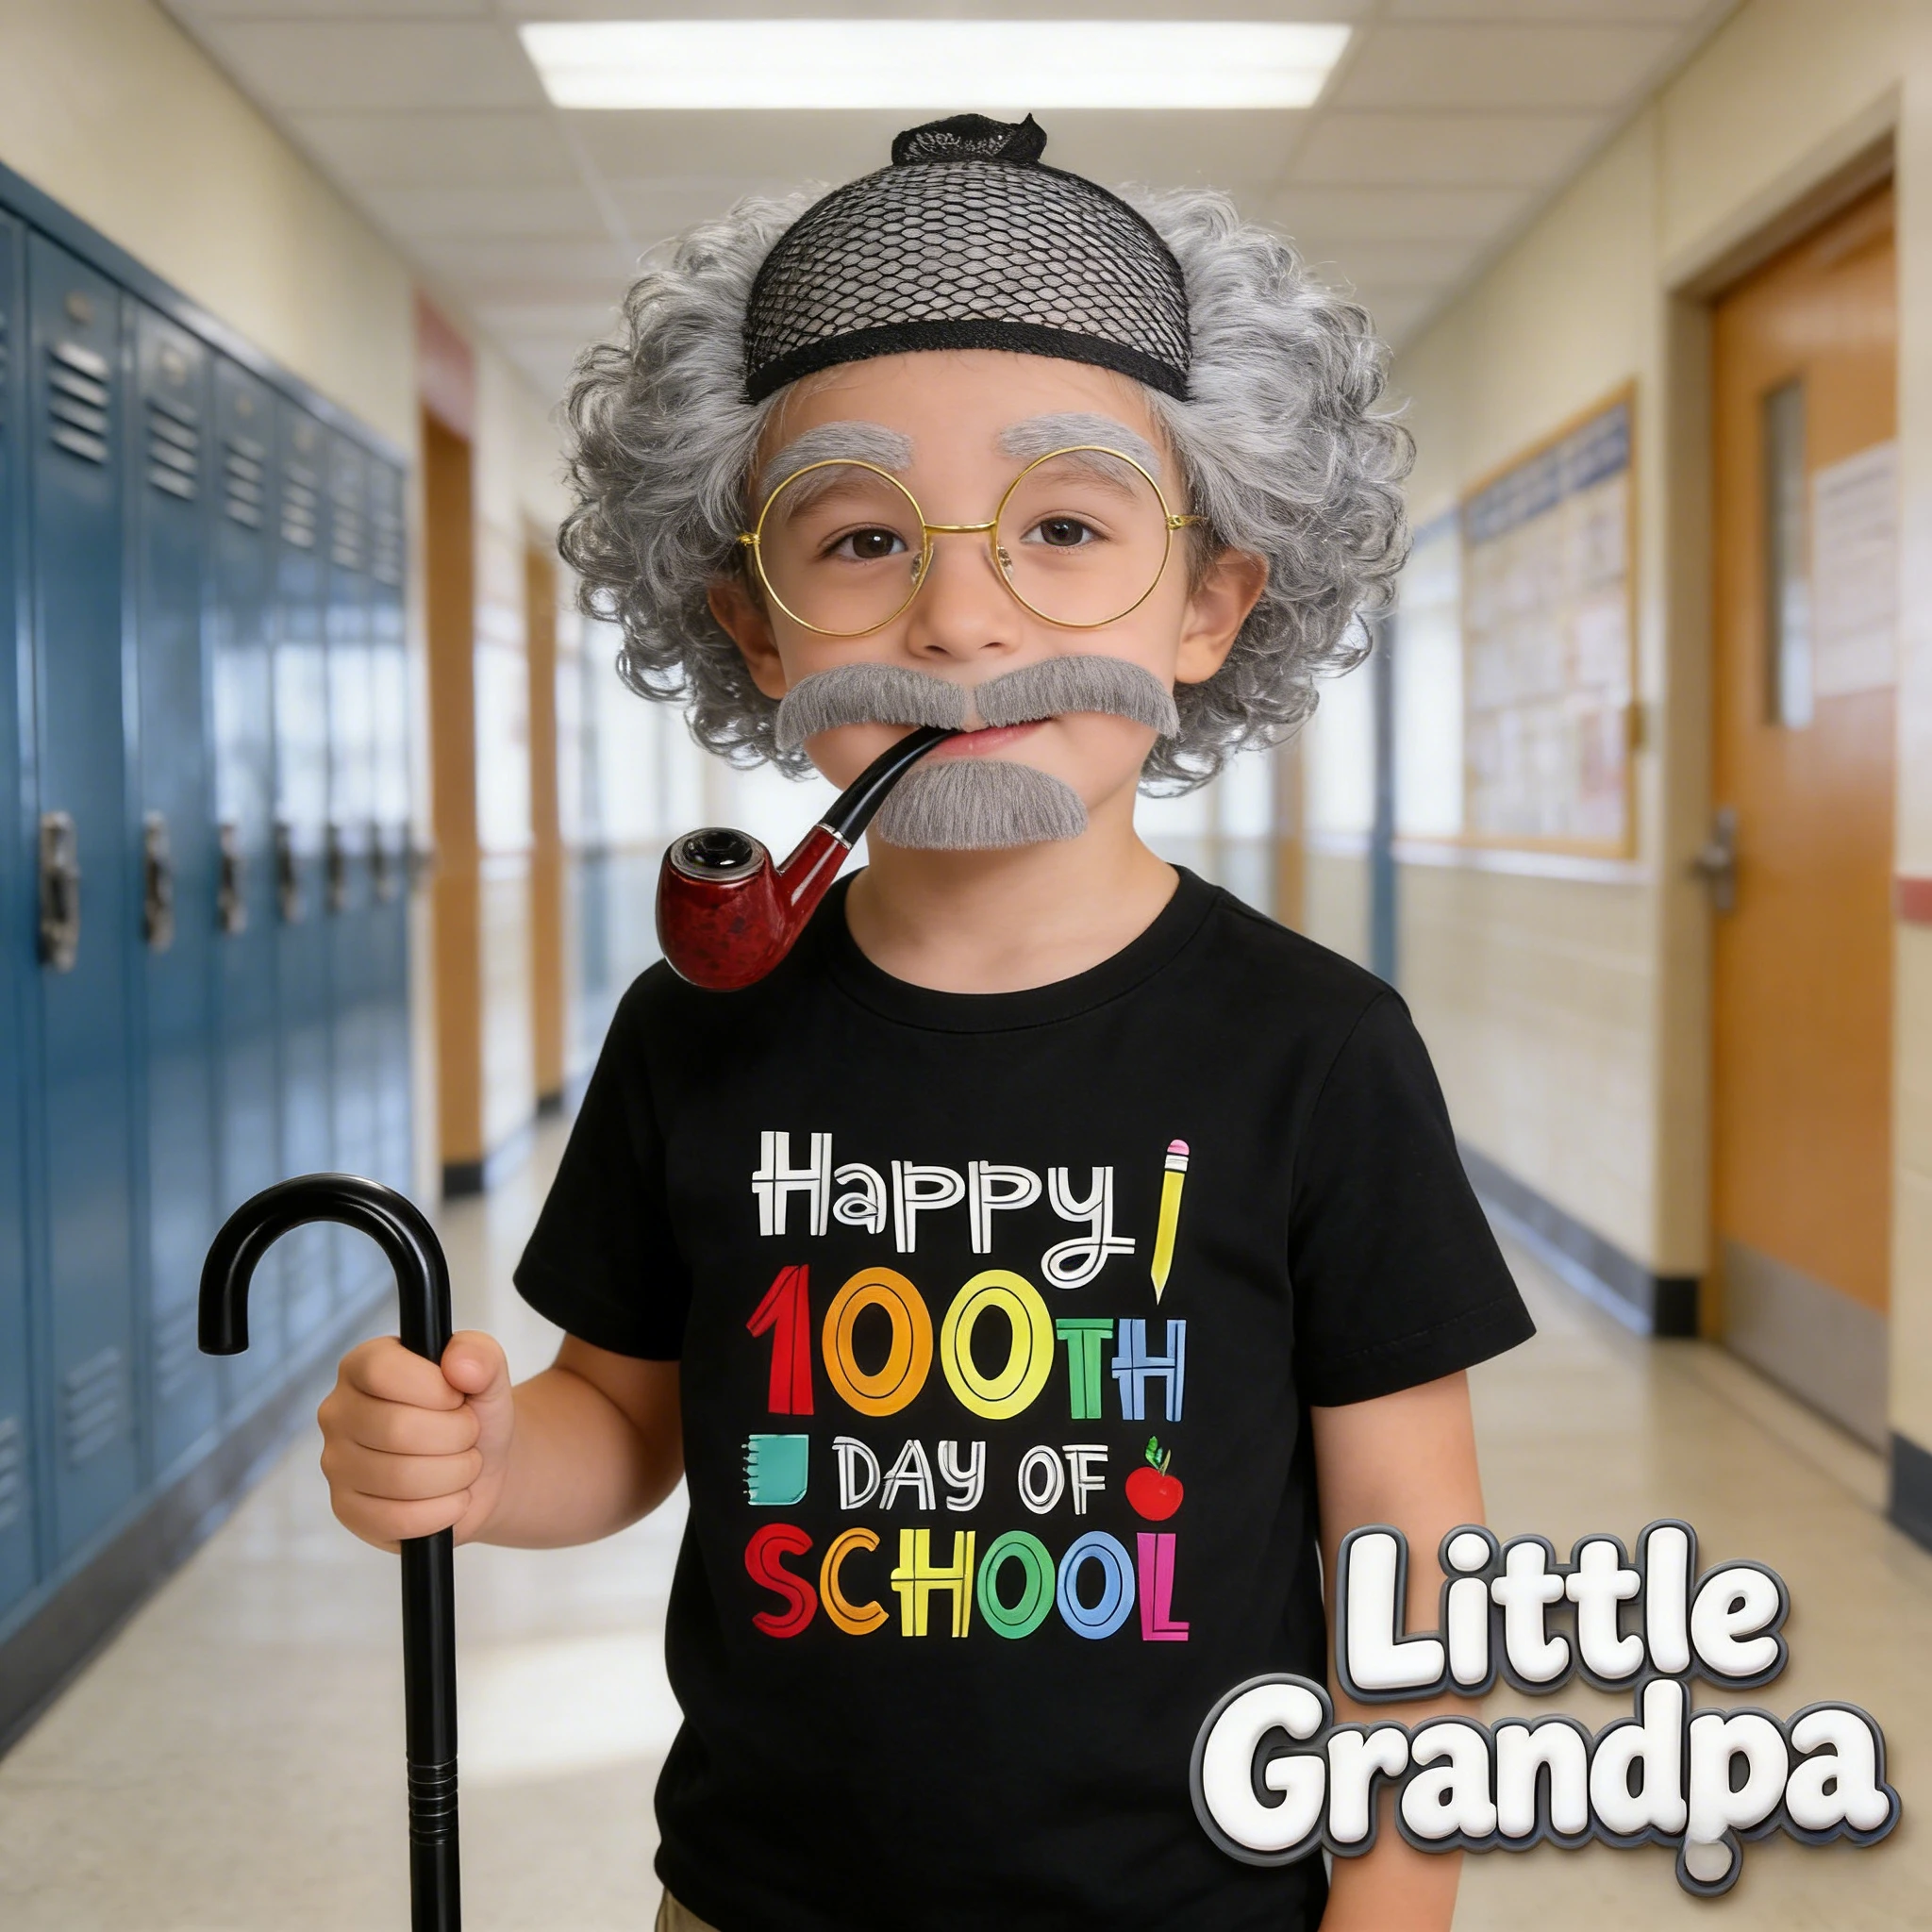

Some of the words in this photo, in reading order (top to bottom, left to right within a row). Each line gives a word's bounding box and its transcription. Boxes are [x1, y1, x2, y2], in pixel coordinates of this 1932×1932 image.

[752, 1130, 1136, 1290] Happy
[745, 1264, 1187, 1423] 100TH
[831, 1435, 987, 1512] DAY
[1018, 1444, 1109, 1515] OF
[744, 1523, 1191, 1641] SCHOOL
